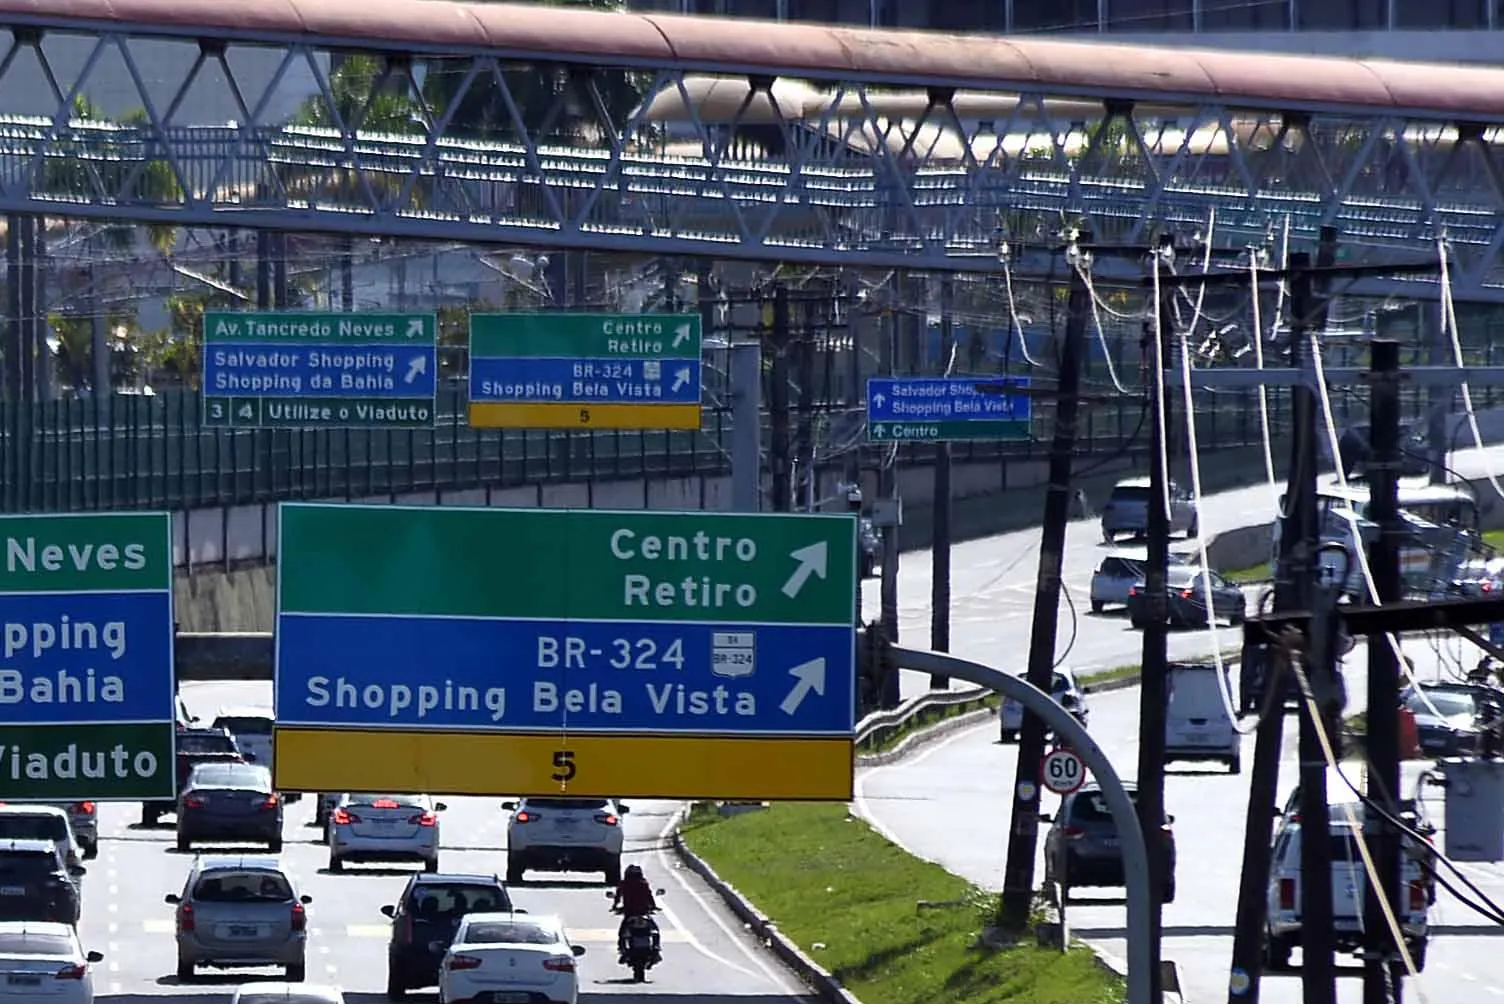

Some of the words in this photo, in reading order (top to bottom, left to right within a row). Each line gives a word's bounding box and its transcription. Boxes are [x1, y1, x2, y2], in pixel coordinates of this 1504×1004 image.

[216, 321, 240, 335] Av.
[246, 320, 330, 336] Tancredo
[339, 321, 393, 336] Neves
[603, 322, 661, 334] Centro
[608, 340, 661, 352] Retiro
[216, 352, 298, 367] Salvador
[309, 353, 393, 372] Shopping
[574, 364, 632, 378] BR-324
[216, 373, 301, 392] Shopping
[311, 374, 332, 388] da
[342, 374, 393, 389] Bahia
[482, 381, 562, 399] Shopping
[573, 382, 608, 396] Bela
[617, 383, 661, 397] Vista
[892, 385, 946, 396] Salvador
[212, 404, 222, 418] 3
[239, 404, 252, 418] 4
[269, 404, 331, 419] Utilize
[340, 408, 348, 419] o
[357, 405, 428, 420] Viaduto
[580, 409, 590, 423] 5
[893, 401, 951, 416] Shopping
[893, 425, 938, 437] Centro
[611, 529, 756, 561] Centro
[8, 538, 145, 571] Neves
[625, 575, 756, 606] Retiro
[538, 637, 684, 669] BR-324
[306, 675, 505, 720] Shopping
[534, 681, 622, 714] Bela
[646, 684, 755, 715] Vista
[551, 751, 576, 781] 5
[1050, 758, 1077, 778] 60
